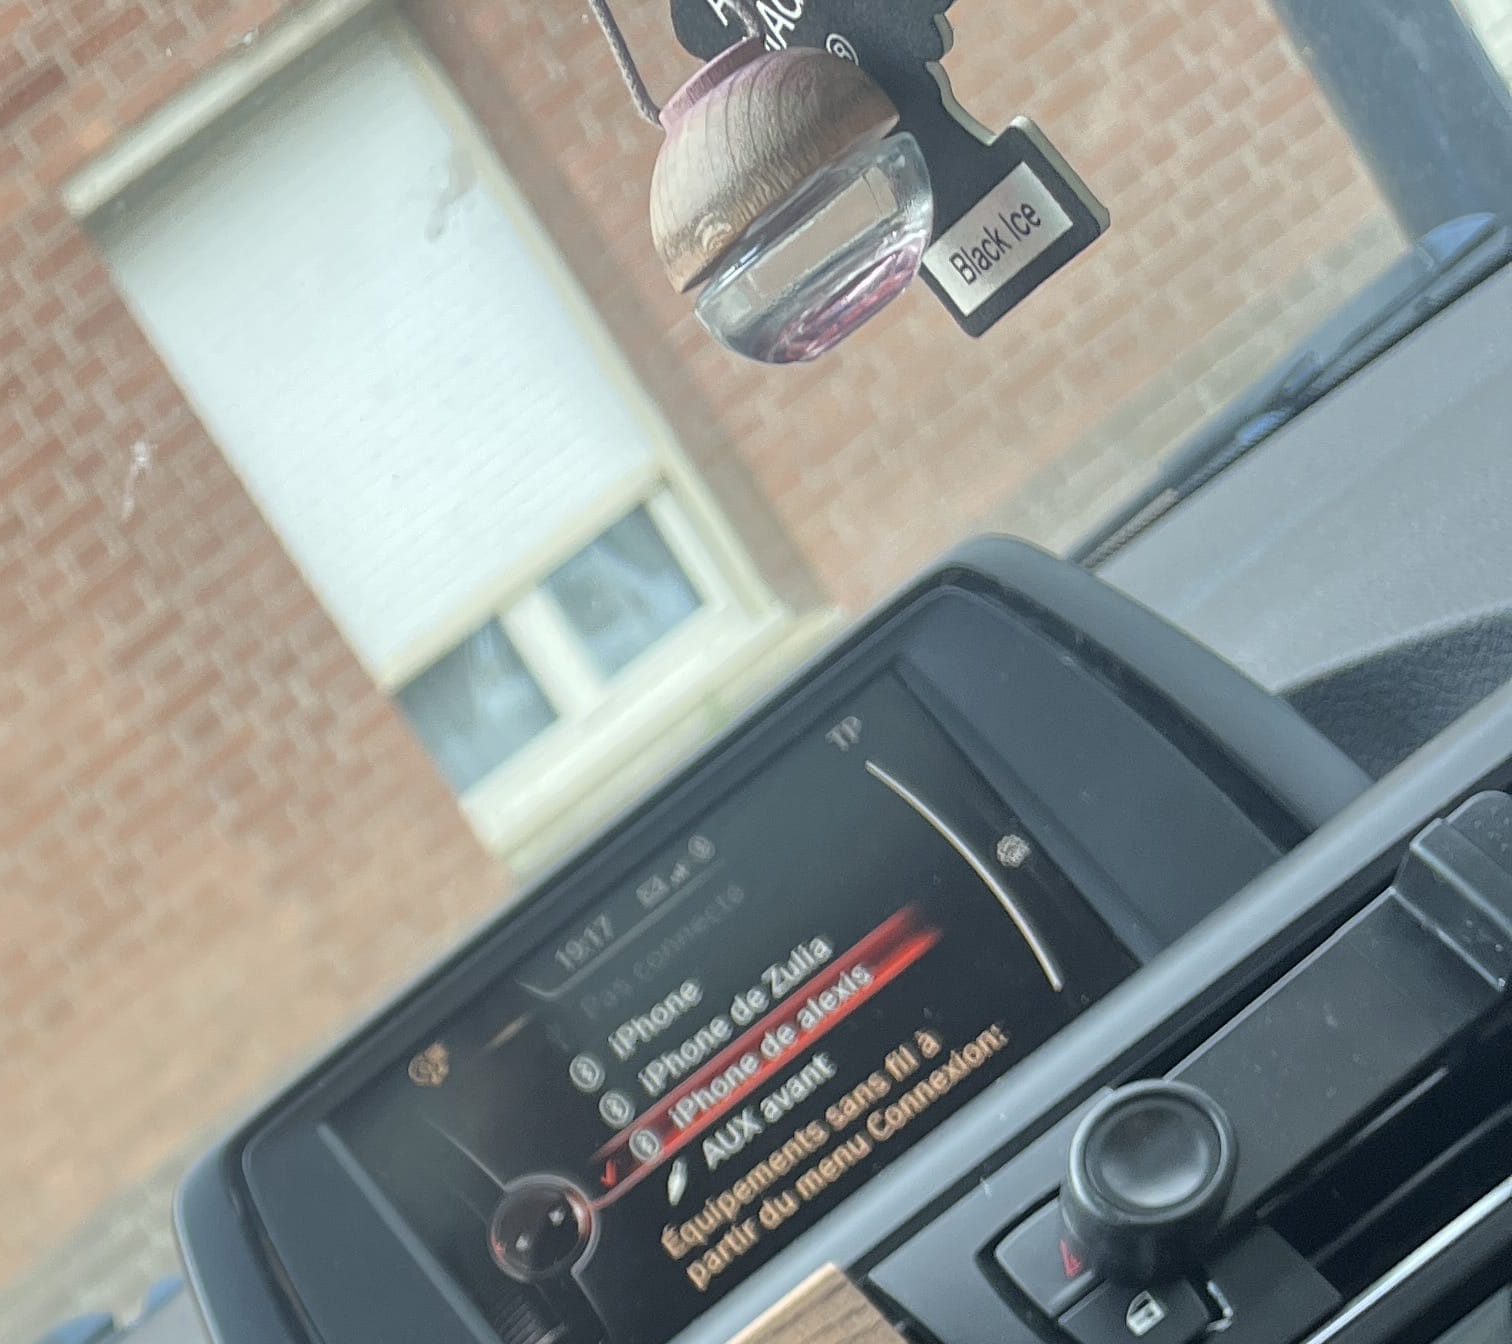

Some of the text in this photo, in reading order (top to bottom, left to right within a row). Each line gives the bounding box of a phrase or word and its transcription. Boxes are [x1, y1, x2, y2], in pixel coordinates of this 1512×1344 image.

[949, 203, 1041, 285] Black Ice
[608, 978, 703, 1061] iPhone
[638, 935, 833, 1096] iPhone de Zulia
[668, 962, 875, 1130] iPhone de alexis
[702, 1053, 837, 1170] AUX avant
[825, 1071, 891, 1131] sans
[884, 1043, 920, 1082] fil
[914, 1027, 942, 1059] à
[687, 1218, 760, 1292] partir
[759, 1190, 801, 1230] du
[795, 1133, 872, 1200] menu
